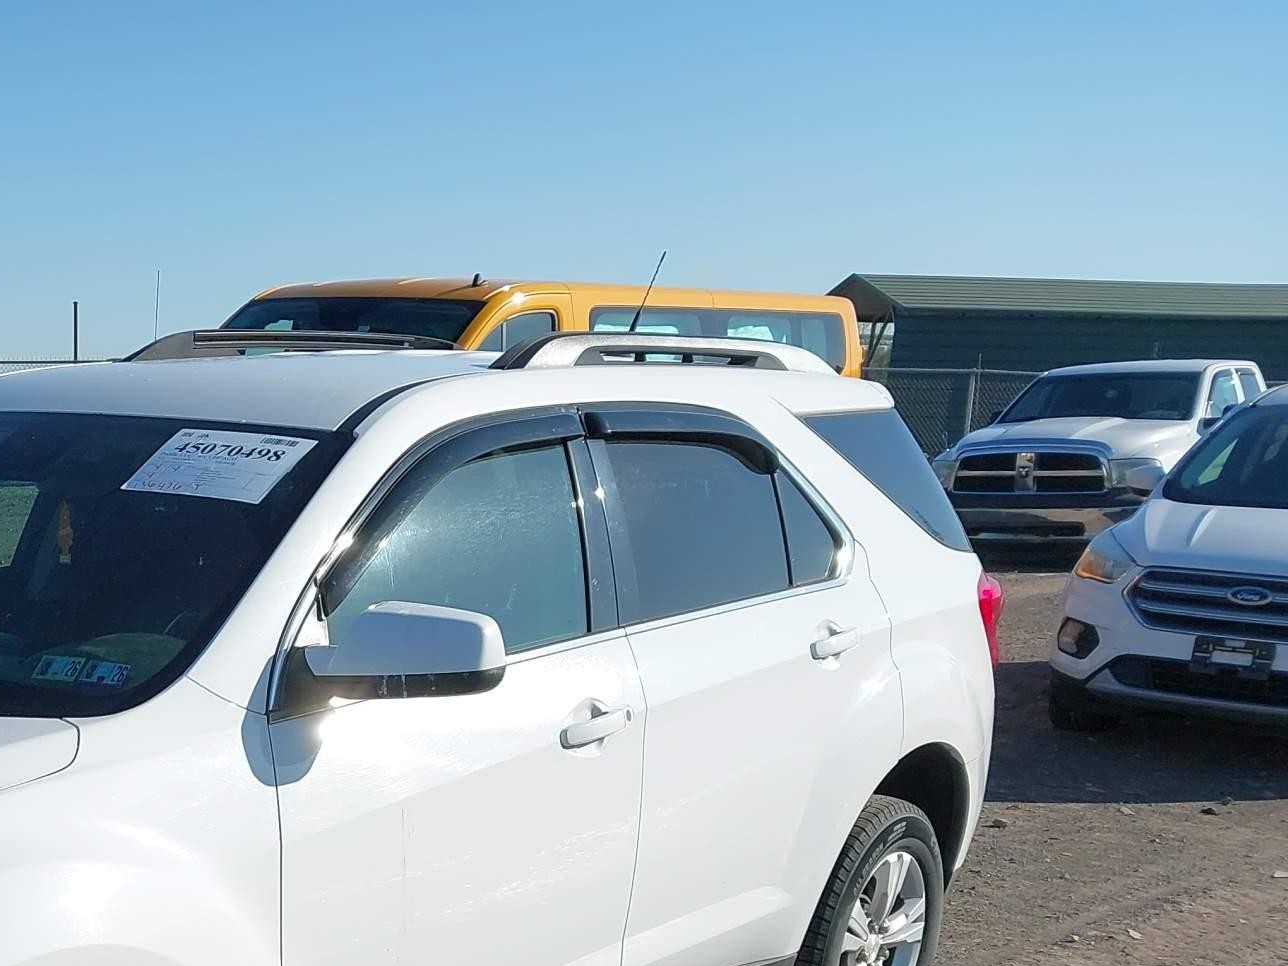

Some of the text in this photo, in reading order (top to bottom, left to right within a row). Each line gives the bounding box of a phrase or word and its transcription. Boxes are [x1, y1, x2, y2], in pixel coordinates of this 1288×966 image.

[175, 441, 287, 462] 45070498
[64, 660, 82, 677] 26
[111, 665, 129, 683] 26
